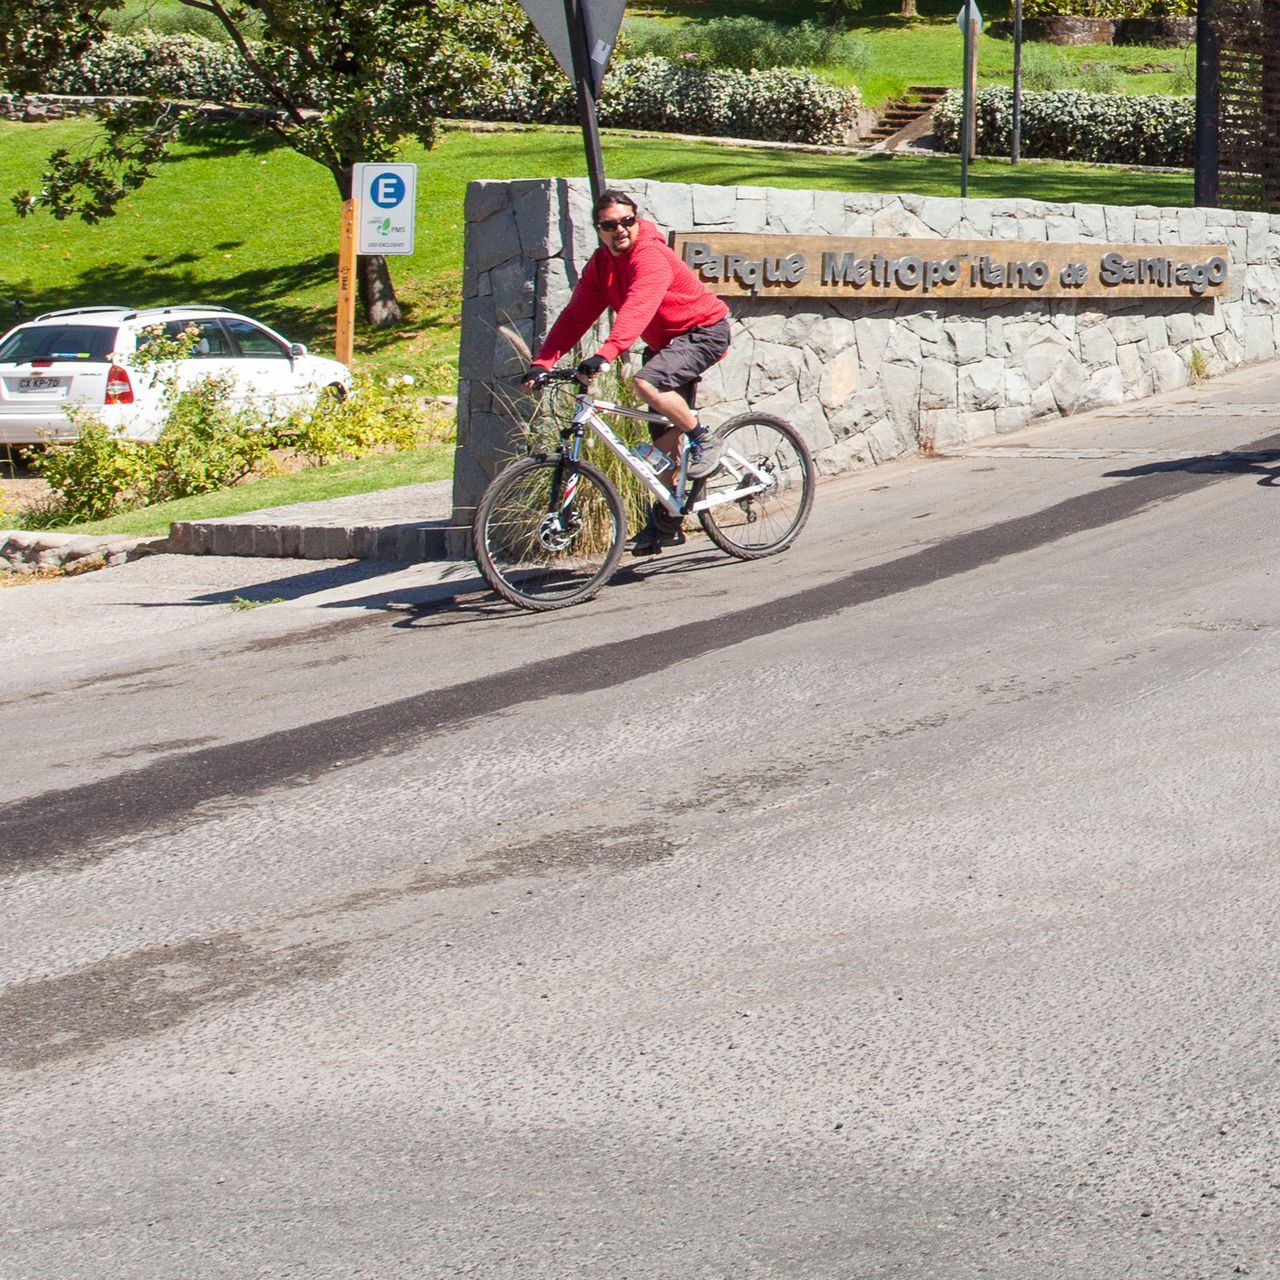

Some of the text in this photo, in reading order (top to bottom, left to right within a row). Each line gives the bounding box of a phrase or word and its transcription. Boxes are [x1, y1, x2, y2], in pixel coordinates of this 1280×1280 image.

[378, 178, 397, 203] E
[682, 241, 806, 293] Parque
[1060, 263, 1089, 289] de
[1099, 252, 1228, 295] Santiago
